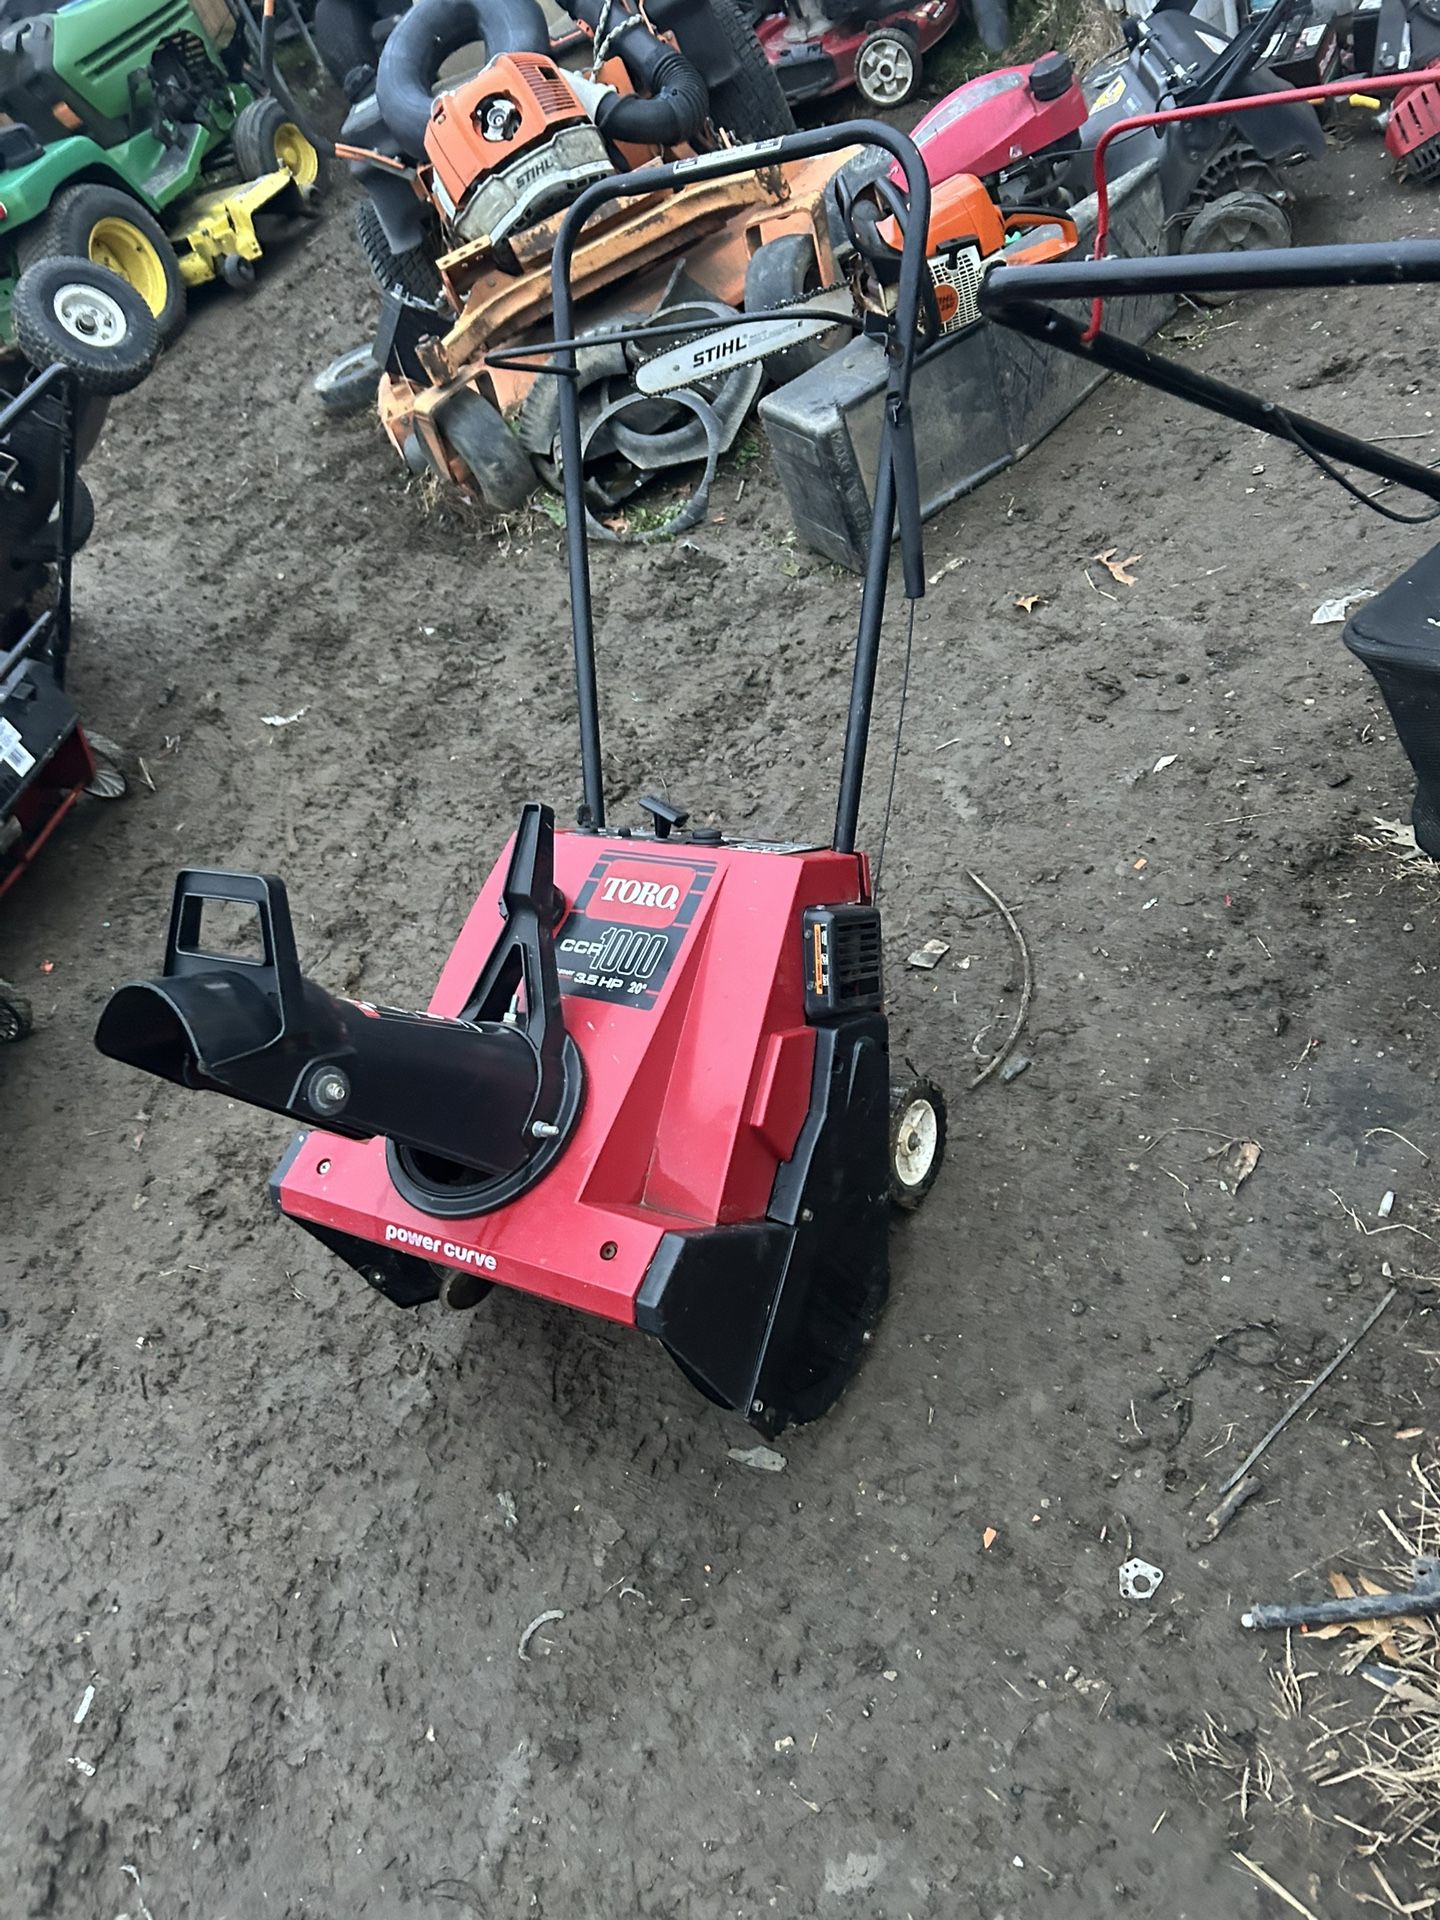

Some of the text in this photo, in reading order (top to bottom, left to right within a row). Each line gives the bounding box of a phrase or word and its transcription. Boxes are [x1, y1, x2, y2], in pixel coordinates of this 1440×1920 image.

[515, 159, 554, 189] STIHL
[693, 335, 747, 368] STIHL
[601, 877, 680, 909] TORO
[560, 927, 669, 979] CCR 1000
[573, 971, 599, 986] 3.5
[598, 976, 624, 989] HP
[385, 1224, 497, 1271] power curve
